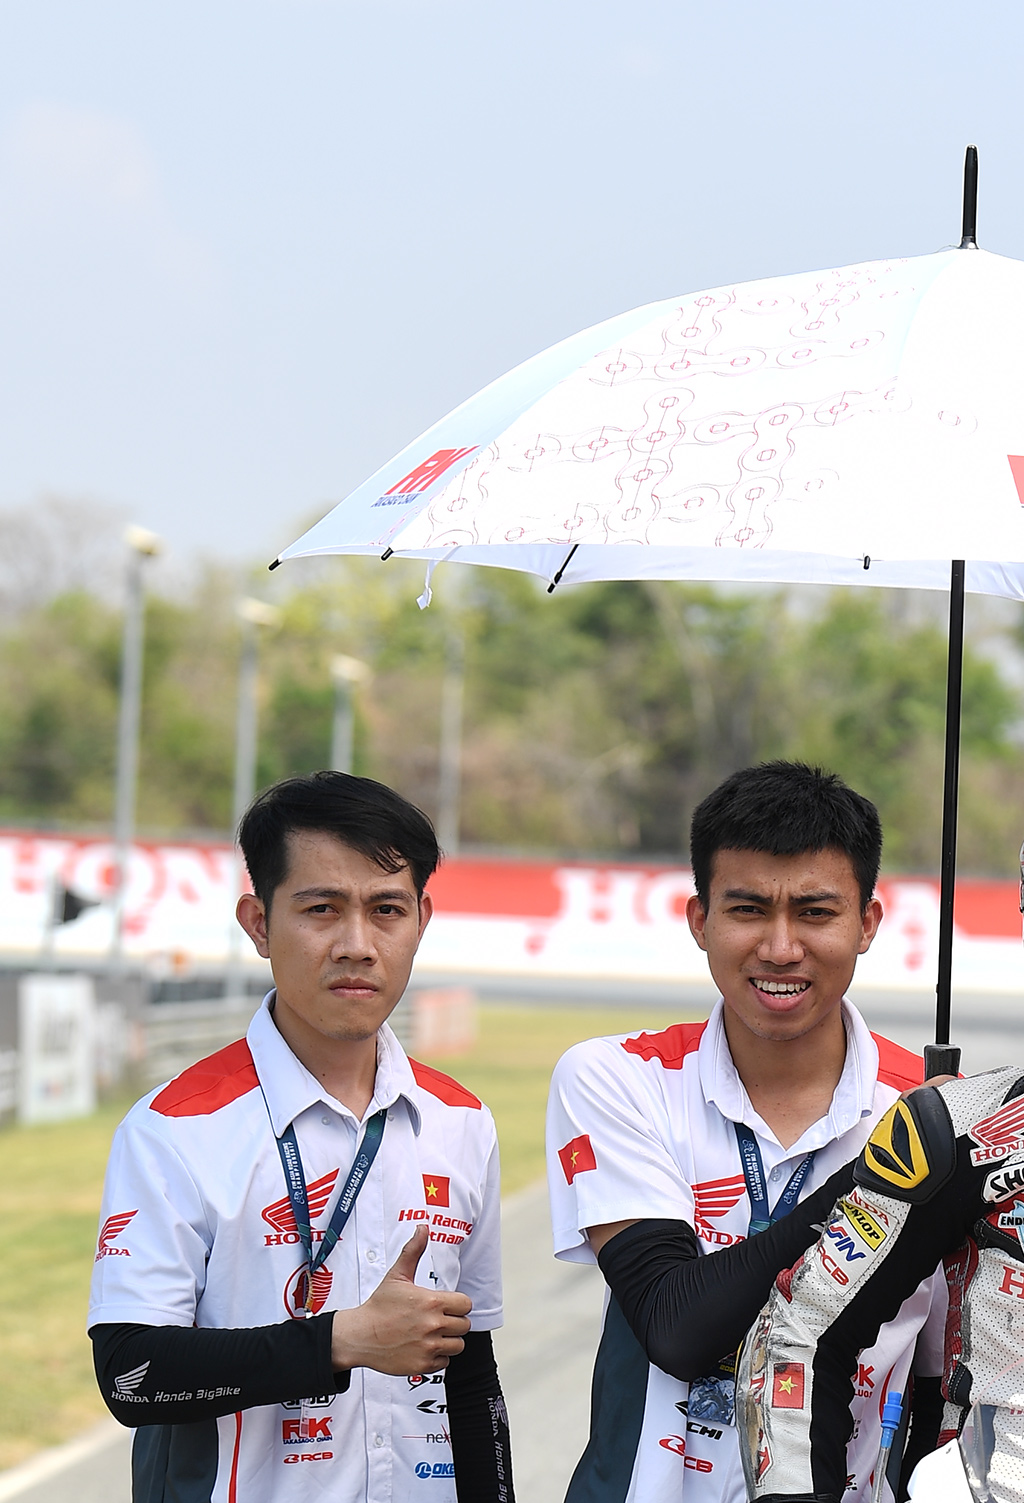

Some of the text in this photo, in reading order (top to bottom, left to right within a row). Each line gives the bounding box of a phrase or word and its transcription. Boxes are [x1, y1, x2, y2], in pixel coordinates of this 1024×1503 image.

[111, 1390, 150, 1403] HONDA
[154, 1386, 242, 1402] Honda BigBike
[301, 1451, 334, 1462] RCB
